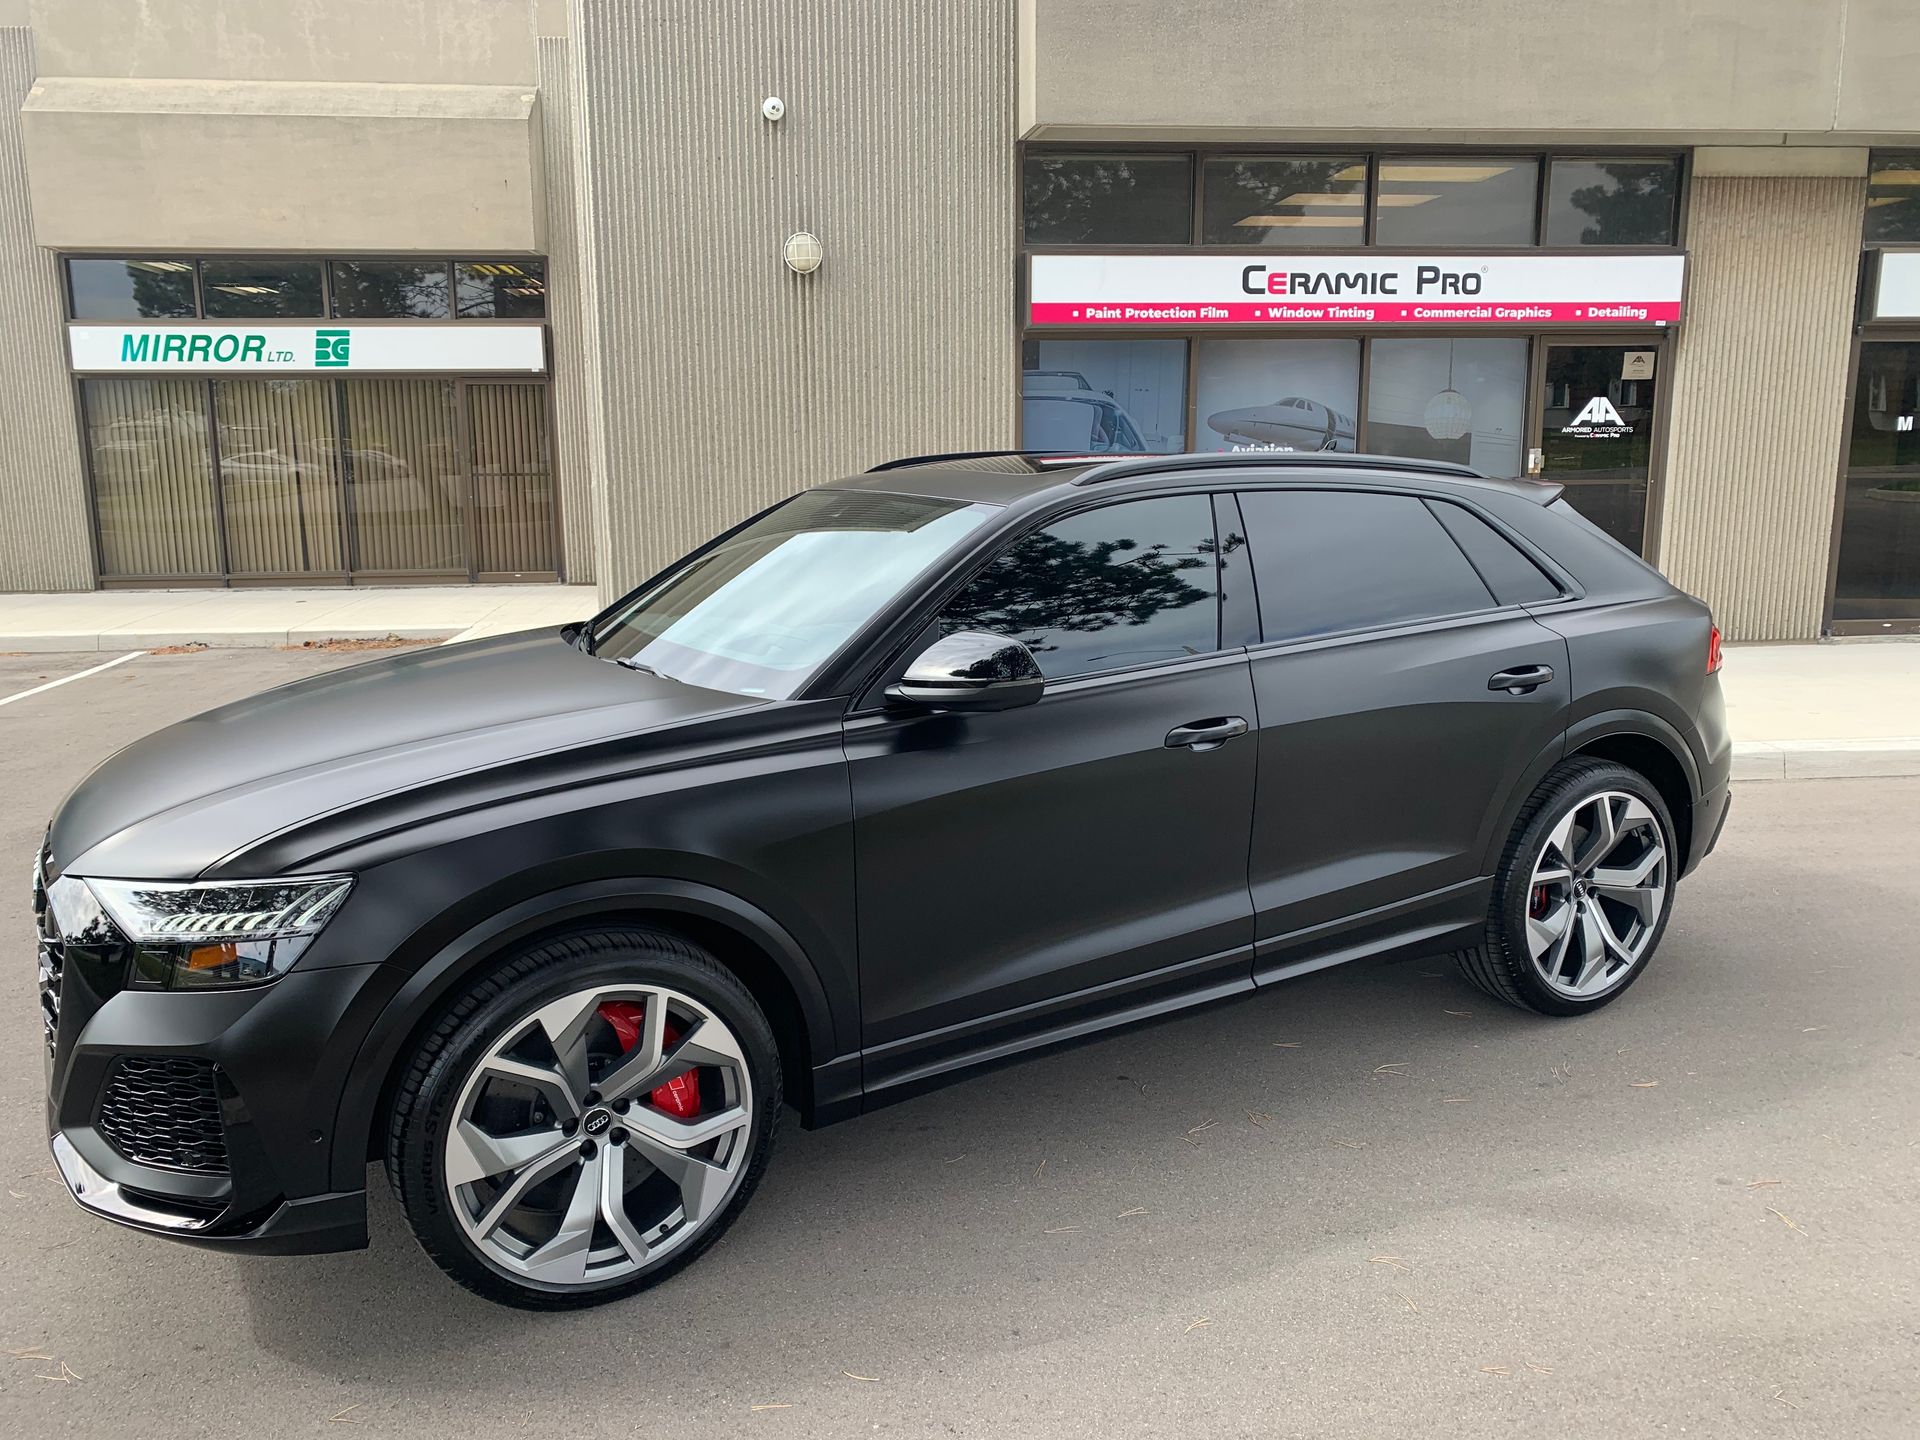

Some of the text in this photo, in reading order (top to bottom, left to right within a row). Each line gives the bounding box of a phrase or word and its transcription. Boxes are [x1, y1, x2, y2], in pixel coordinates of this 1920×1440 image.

[1085, 306, 1648, 320] Paint Protection Film Window Tinting Commercial Graphics Detailing
[120, 334, 267, 363] MIRROR
[267, 351, 296, 363] LTD.
[1897, 415, 1914, 431] M
[672, 1090, 684, 1112] ceramic
